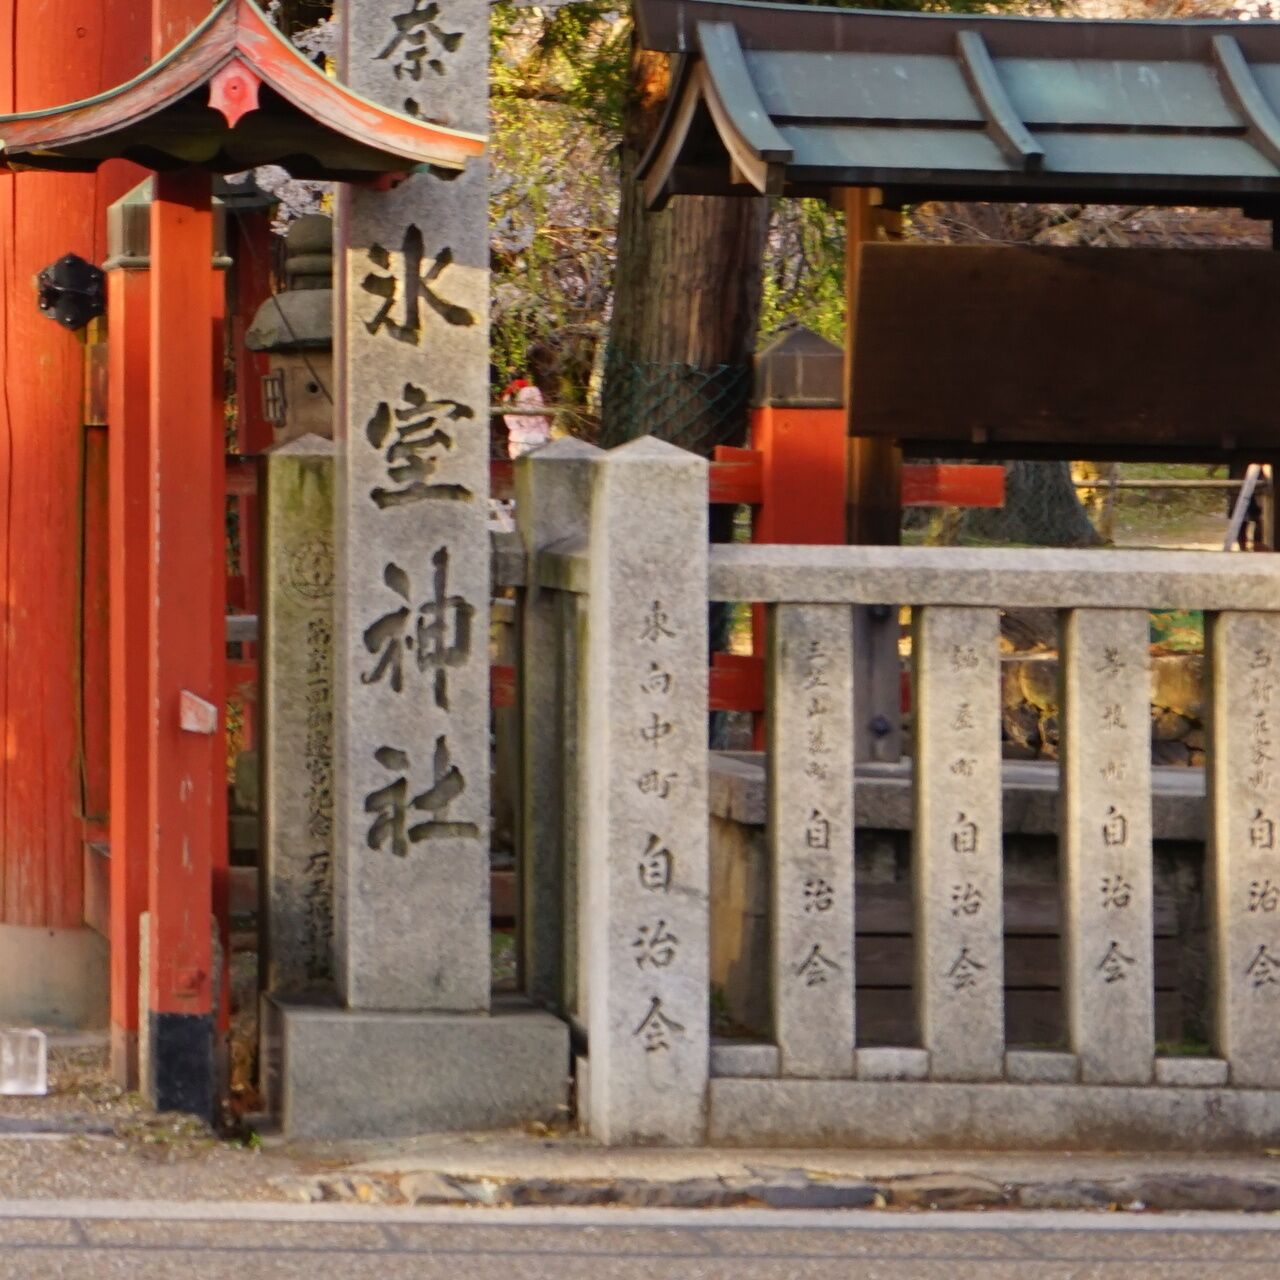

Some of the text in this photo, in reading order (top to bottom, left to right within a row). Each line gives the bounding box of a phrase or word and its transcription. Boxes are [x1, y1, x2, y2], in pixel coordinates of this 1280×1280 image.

[629, 598, 686, 1053] 東向中町自治会
